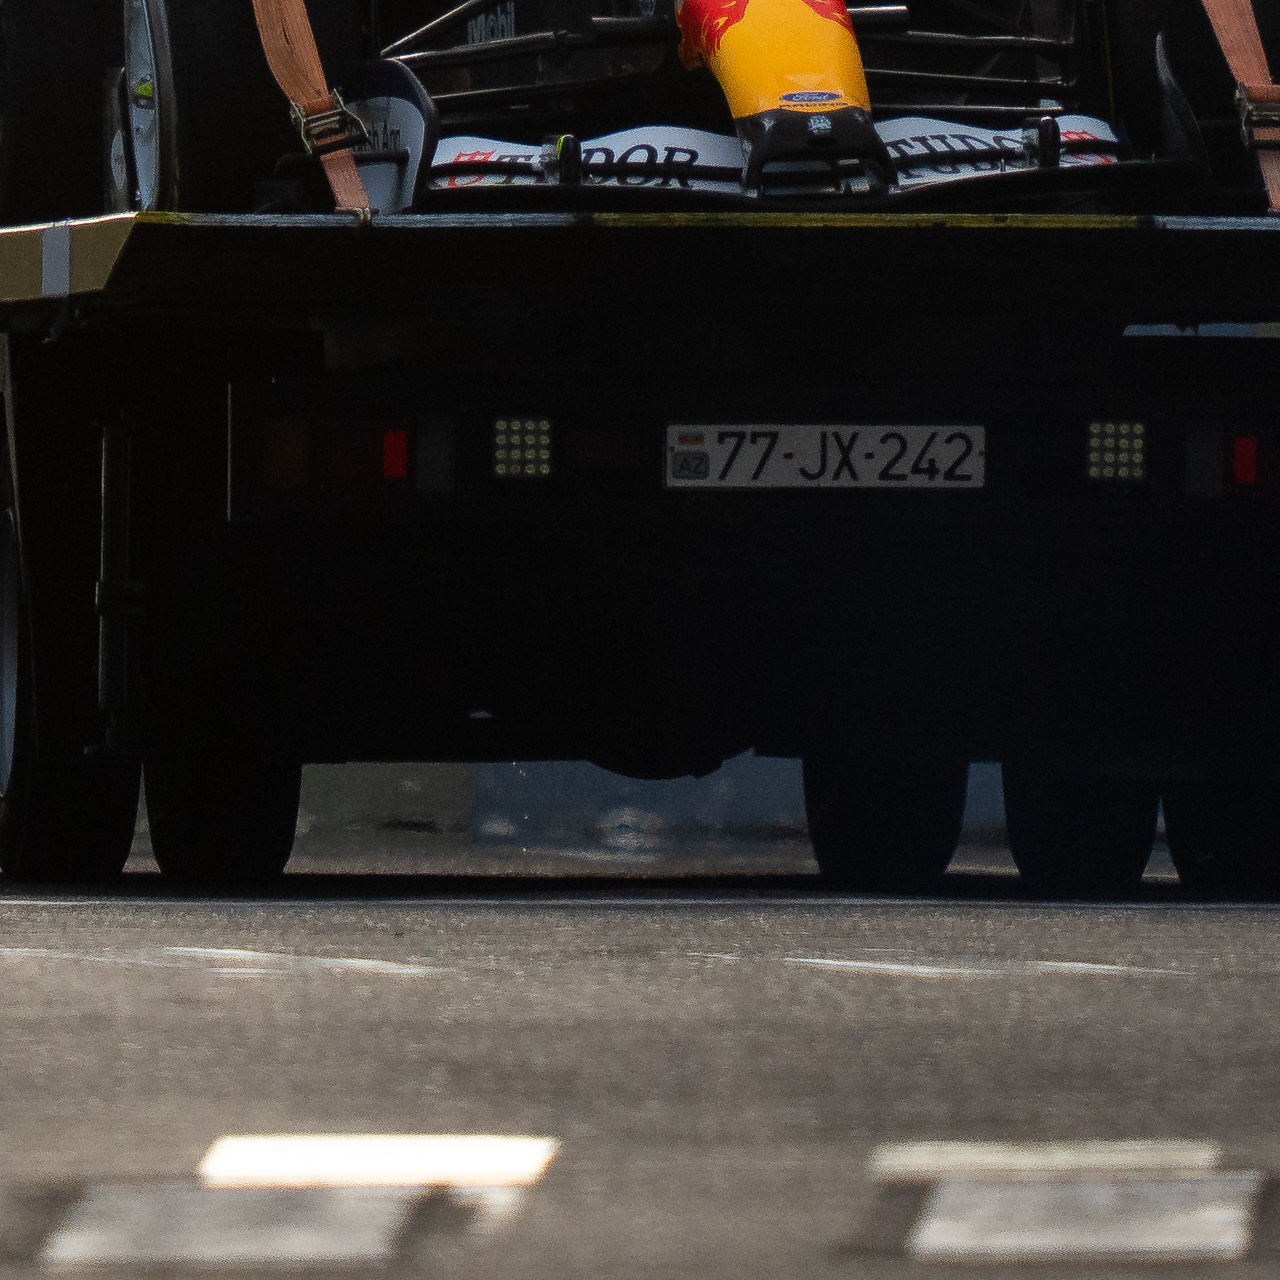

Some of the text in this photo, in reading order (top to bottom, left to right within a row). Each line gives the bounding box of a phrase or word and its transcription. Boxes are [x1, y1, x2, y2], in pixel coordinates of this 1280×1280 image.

[792, 93, 829, 101] Ford
[496, 144, 699, 188] TDOR
[678, 456, 706, 474] AZ
